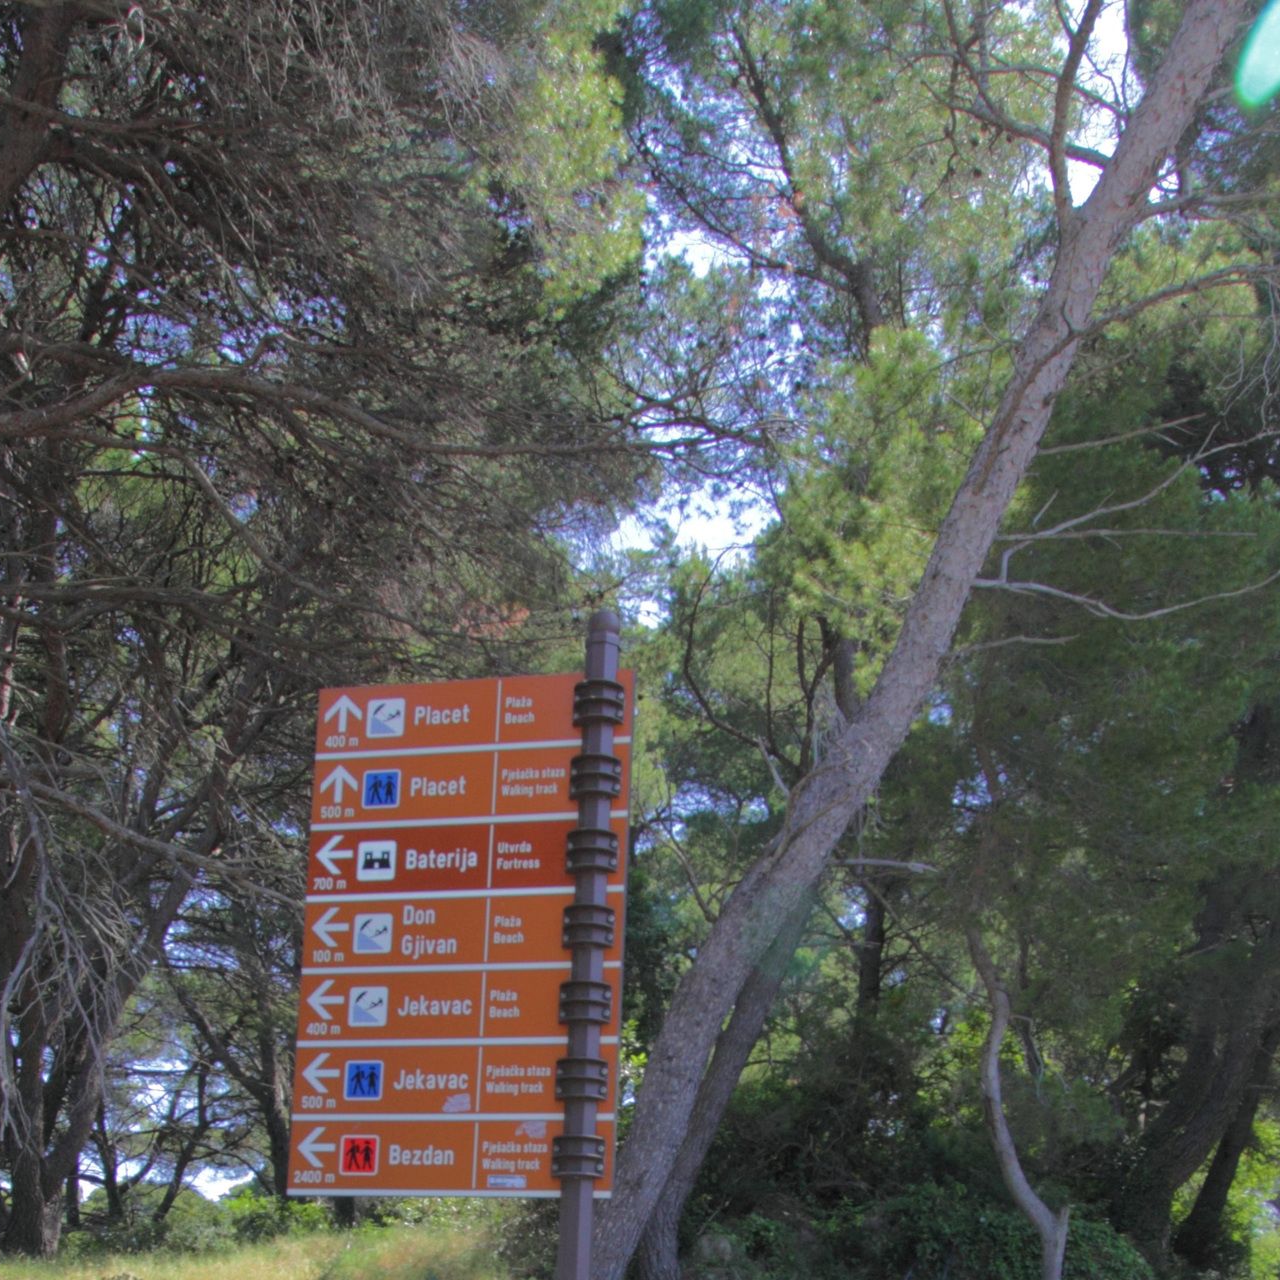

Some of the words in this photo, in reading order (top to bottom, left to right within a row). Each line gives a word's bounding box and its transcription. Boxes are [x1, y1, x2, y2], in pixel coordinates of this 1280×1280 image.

[505, 697, 533, 709] Plaža
[414, 705, 470, 725] Placet
[504, 711, 535, 725] Beach
[324, 736, 346, 748] 400
[349, 736, 358, 746] m
[541, 766, 566, 778] staza
[410, 776, 466, 797] Placet
[501, 784, 534, 798] Walking
[535, 782, 558, 794] track
[320, 806, 342, 819] 500
[344, 807, 355, 817] m
[497, 841, 532, 854] Utvrda
[405, 848, 477, 872] Baterija
[496, 857, 540, 870] Fortress
[313, 877, 334, 890] 700
[336, 879, 347, 889] m
[403, 905, 436, 925] Don
[494, 915, 522, 927] Plaža
[493, 931, 524, 944] Beach
[401, 934, 457, 960] Gjivan
[313, 949, 331, 962] 100
[334, 951, 344, 961] m
[490, 989, 518, 1002] Plaža
[397, 995, 472, 1017] Jekavac
[489, 1005, 520, 1018] Beach
[306, 1022, 328, 1035] 400
[330, 1024, 341, 1034] m
[527, 1065, 551, 1076] staza
[393, 1069, 469, 1090] Jekavac
[486, 1081, 518, 1096] Walking
[520, 1081, 544, 1093] track
[301, 1096, 323, 1109] 500
[325, 1098, 336, 1108] m
[523, 1142, 548, 1153] staza
[388, 1145, 454, 1166] Bezdan
[482, 1158, 515, 1172] Walking
[517, 1157, 540, 1169] track
[294, 1171, 322, 1183] 2400
[324, 1172, 335, 1183] m
